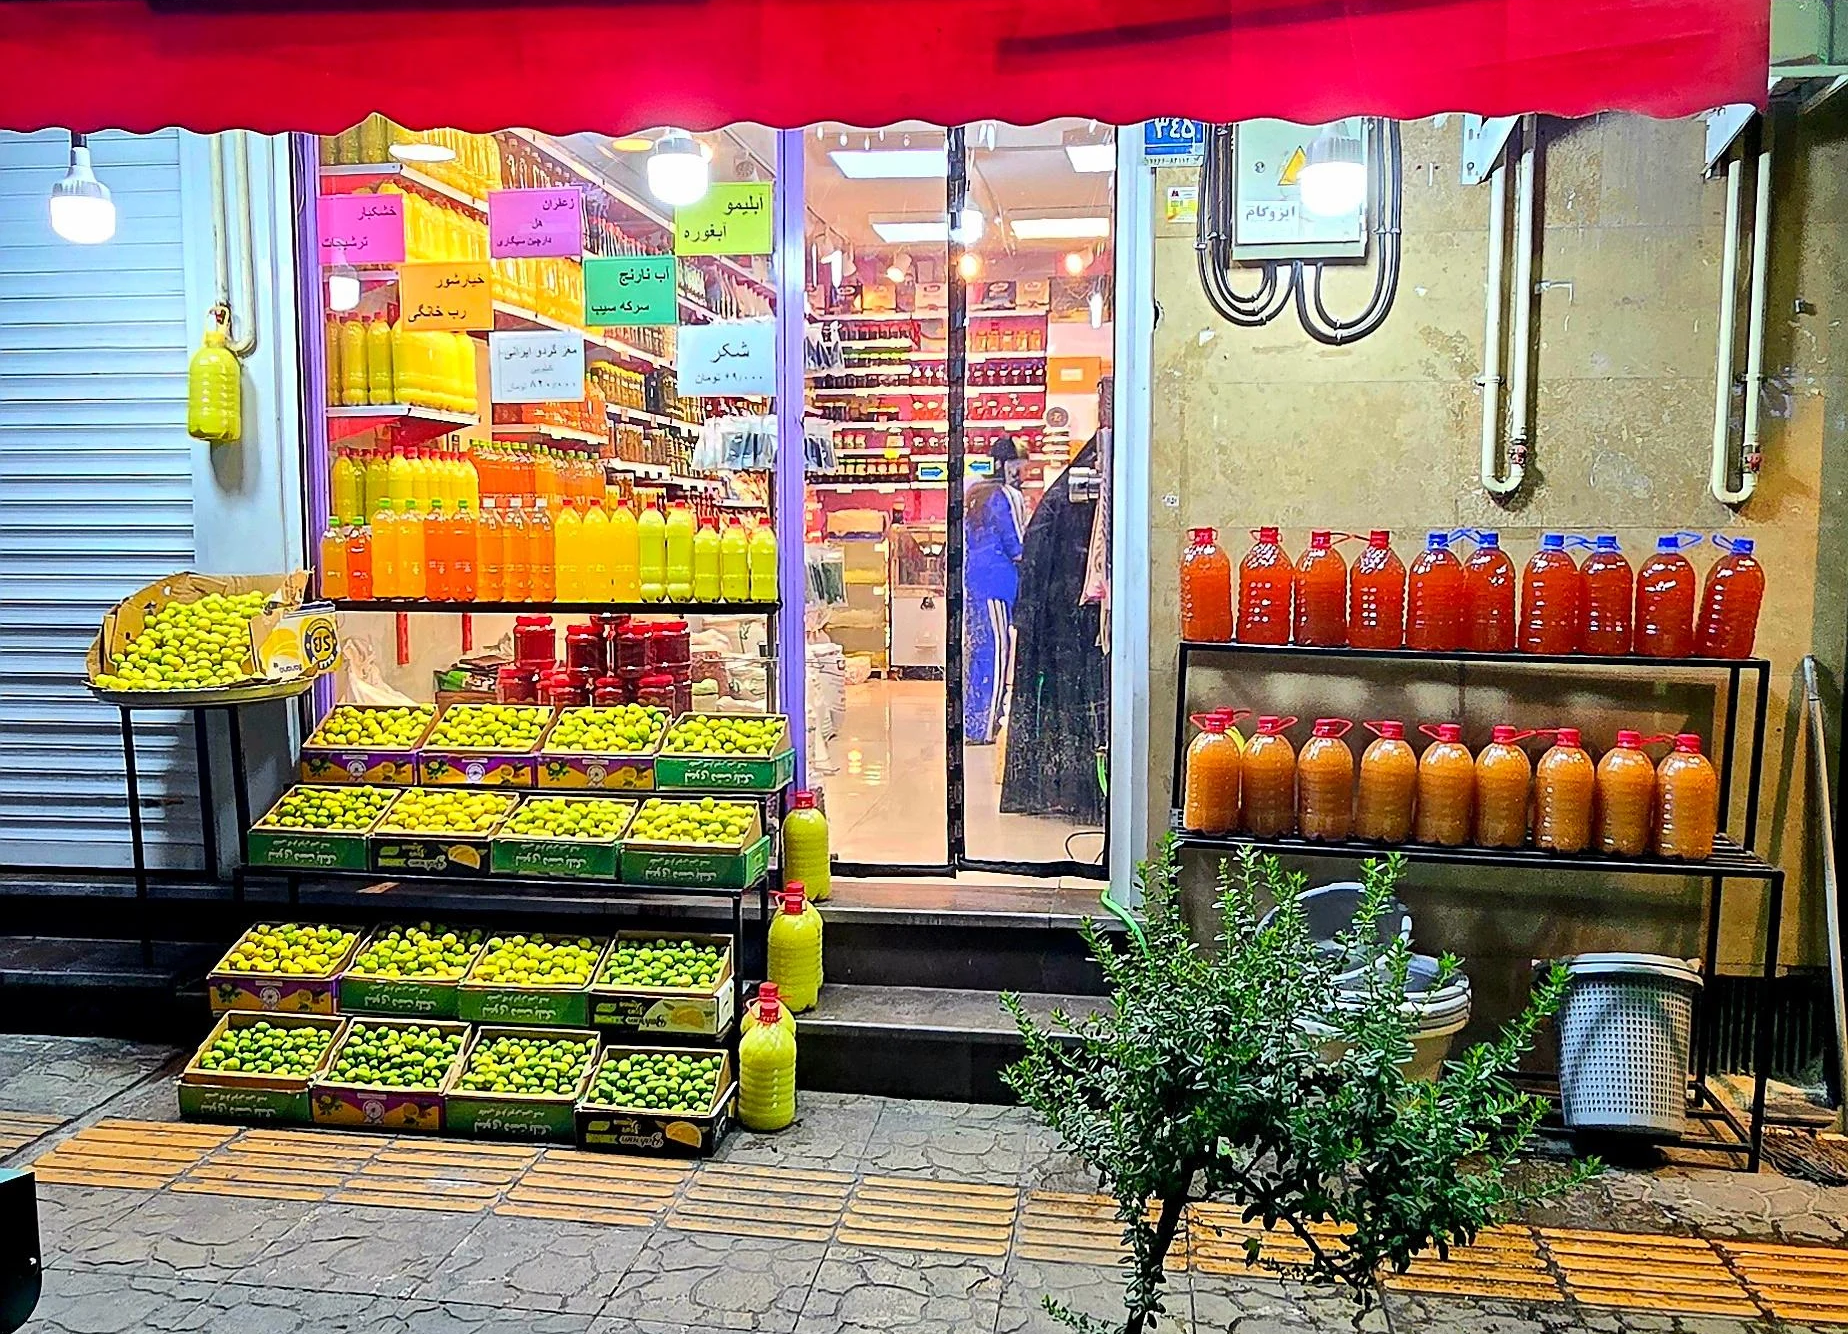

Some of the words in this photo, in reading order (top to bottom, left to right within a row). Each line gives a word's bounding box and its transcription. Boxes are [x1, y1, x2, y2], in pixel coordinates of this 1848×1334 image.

[542, 199, 575, 211] زعفران
[724, 194, 763, 216] آبلیمو
[358, 206, 396, 221] خشکبار
[532, 219, 542, 229] هل
[321, 236, 368, 250] ترشیجات
[619, 267, 650, 286] نارنج
[408, 305, 444, 323] خانگی
[448, 310, 466, 318] رب
[591, 305, 616, 315] سیب
[620, 301, 649, 314] سرکه
[561, 346, 577, 357] مغز
[711, 342, 750, 362] شکر
